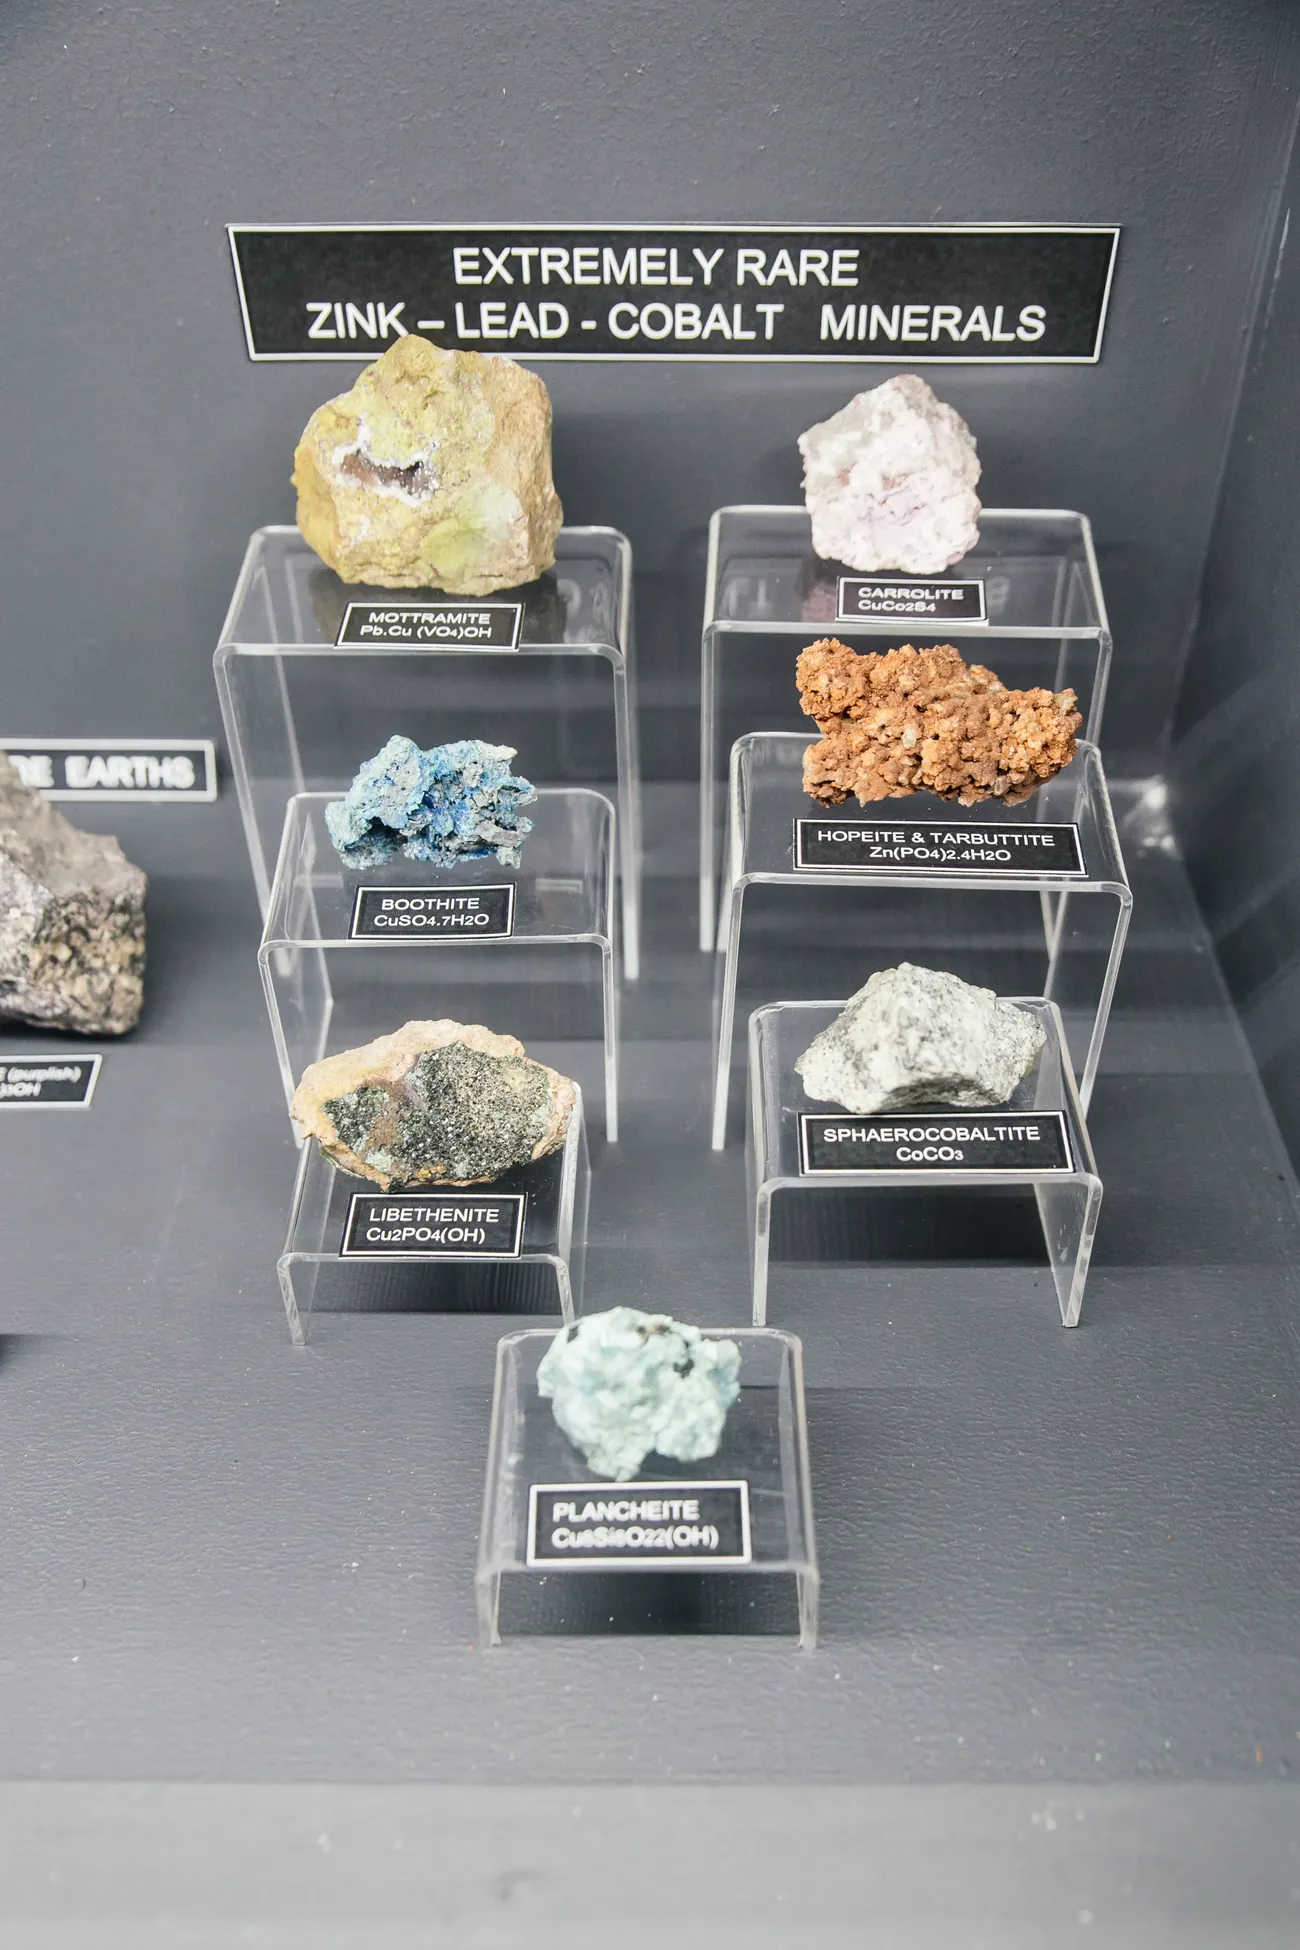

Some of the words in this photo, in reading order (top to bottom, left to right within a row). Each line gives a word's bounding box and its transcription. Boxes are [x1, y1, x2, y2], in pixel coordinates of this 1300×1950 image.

[453, 247, 722, 286] EXTREMELY
[737, 248, 860, 286] RARE
[305, 302, 410, 339] ZINK
[455, 302, 570, 339] LEAD
[608, 302, 785, 340] COBALT
[820, 304, 1047, 342] MINERALS
[857, 587, 964, 600] CARROLITE
[368, 612, 491, 625] MOTTRAMITE
[359, 624, 413, 637] Pb.Cu
[416, 625, 493, 639] (VO4)OH
[64, 755, 196, 789] EARTHS
[817, 830, 906, 843] HOPEITE
[911, 832, 926, 844] &
[929, 832, 1056, 847] TARBUTTITE
[869, 846, 1012, 862] Zn(PO4)2.4H2O
[381, 897, 480, 911] BOOTHITE
[373, 913, 490, 927] CuSO4.7H2O
[823, 1126, 1041, 1143] SPHAEROCOBALTITE
[896, 1146, 964, 1162] CoCO3
[369, 1207, 500, 1223] LIBETHENITE
[366, 1227, 486, 1245] Cu2PO4(OH)
[552, 1499, 701, 1523] PLANCHEITE
